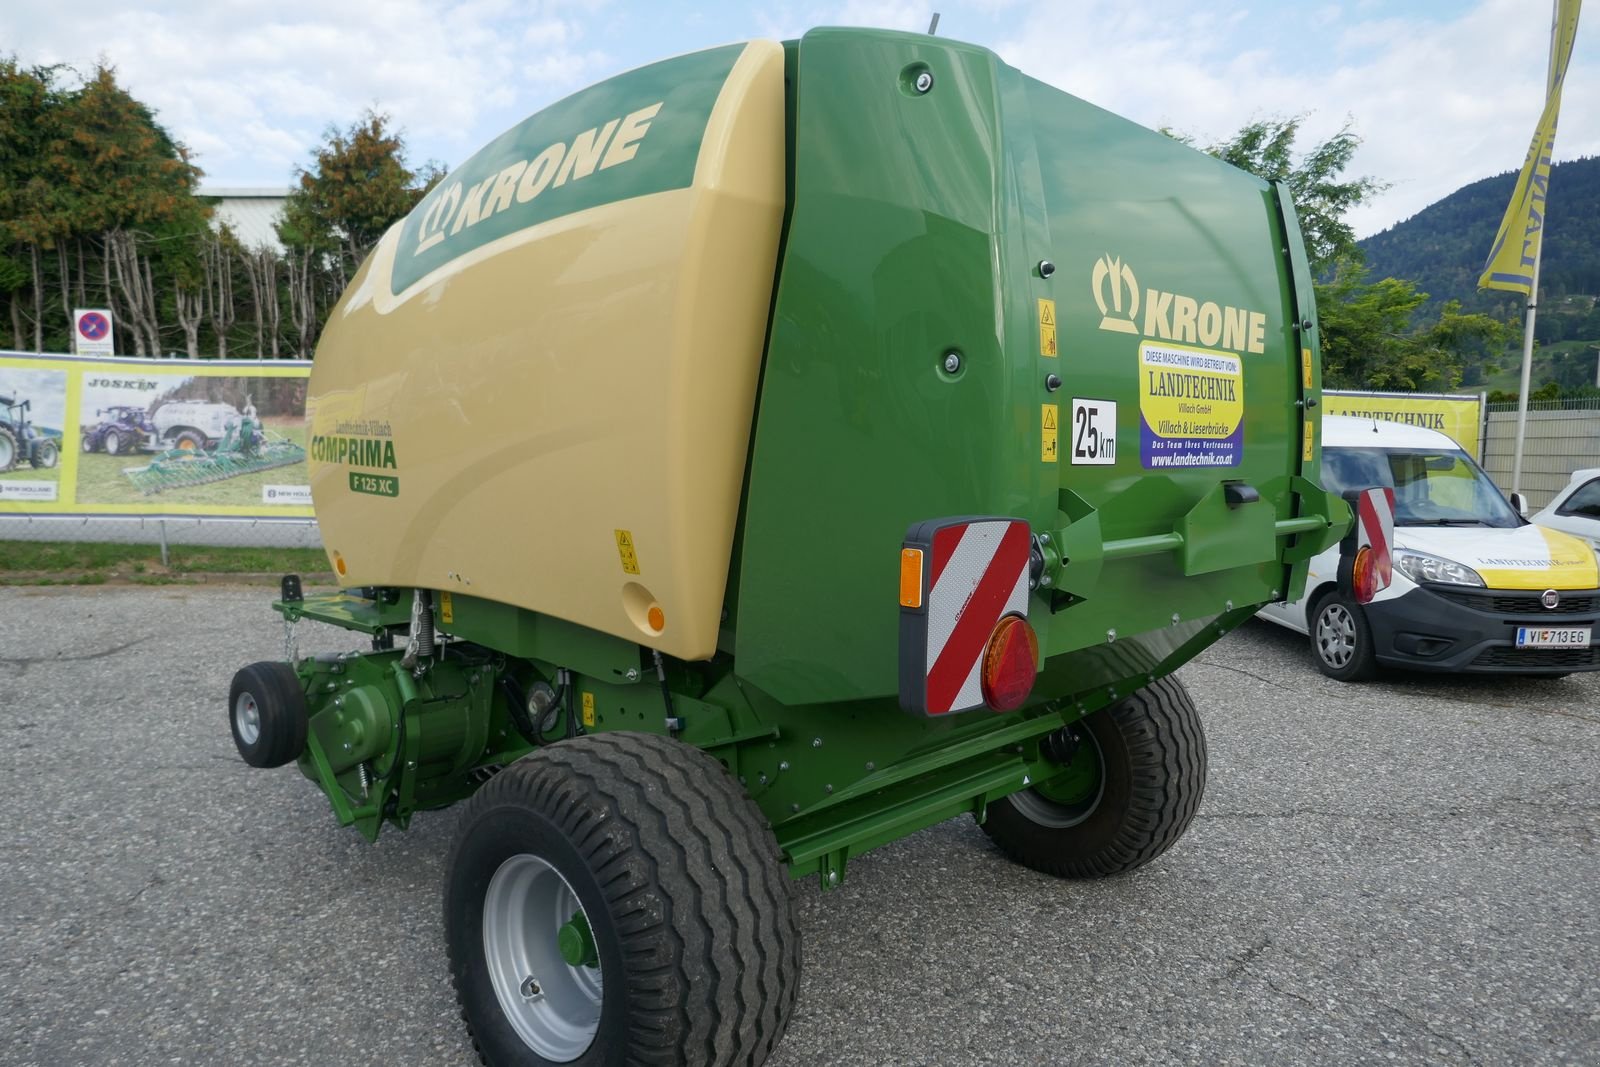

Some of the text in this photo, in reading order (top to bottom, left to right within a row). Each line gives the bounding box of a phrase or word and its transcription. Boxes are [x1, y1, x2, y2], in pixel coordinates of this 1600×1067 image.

[451, 102, 664, 236] KRONE
[1144, 289, 1265, 354] KRONE
[1146, 350, 1162, 363] DIESE
[1163, 352, 1190, 366] MASCHINE
[1190, 356, 1203, 368] WIRD
[1204, 358, 1225, 370] BETREUT
[88, 378, 159, 391] JOSKIN
[1149, 370, 1236, 402] LANDTECHNIK
[1178, 403, 1212, 415] Villach GmbH
[1075, 405, 1114, 459] 25 km
[1158, 420, 1229, 435] Villach & Lieserbrücke
[311, 435, 397, 469] COMPRIMA
[1152, 439, 1233, 449] Das Team Ihres Vertrauens
[1152, 451, 1233, 467] www.landtechnik.co.at
[353, 475, 393, 494] F 125 XC
[1530, 630, 1541, 643] VI
[1549, 631, 1568, 643] 713
